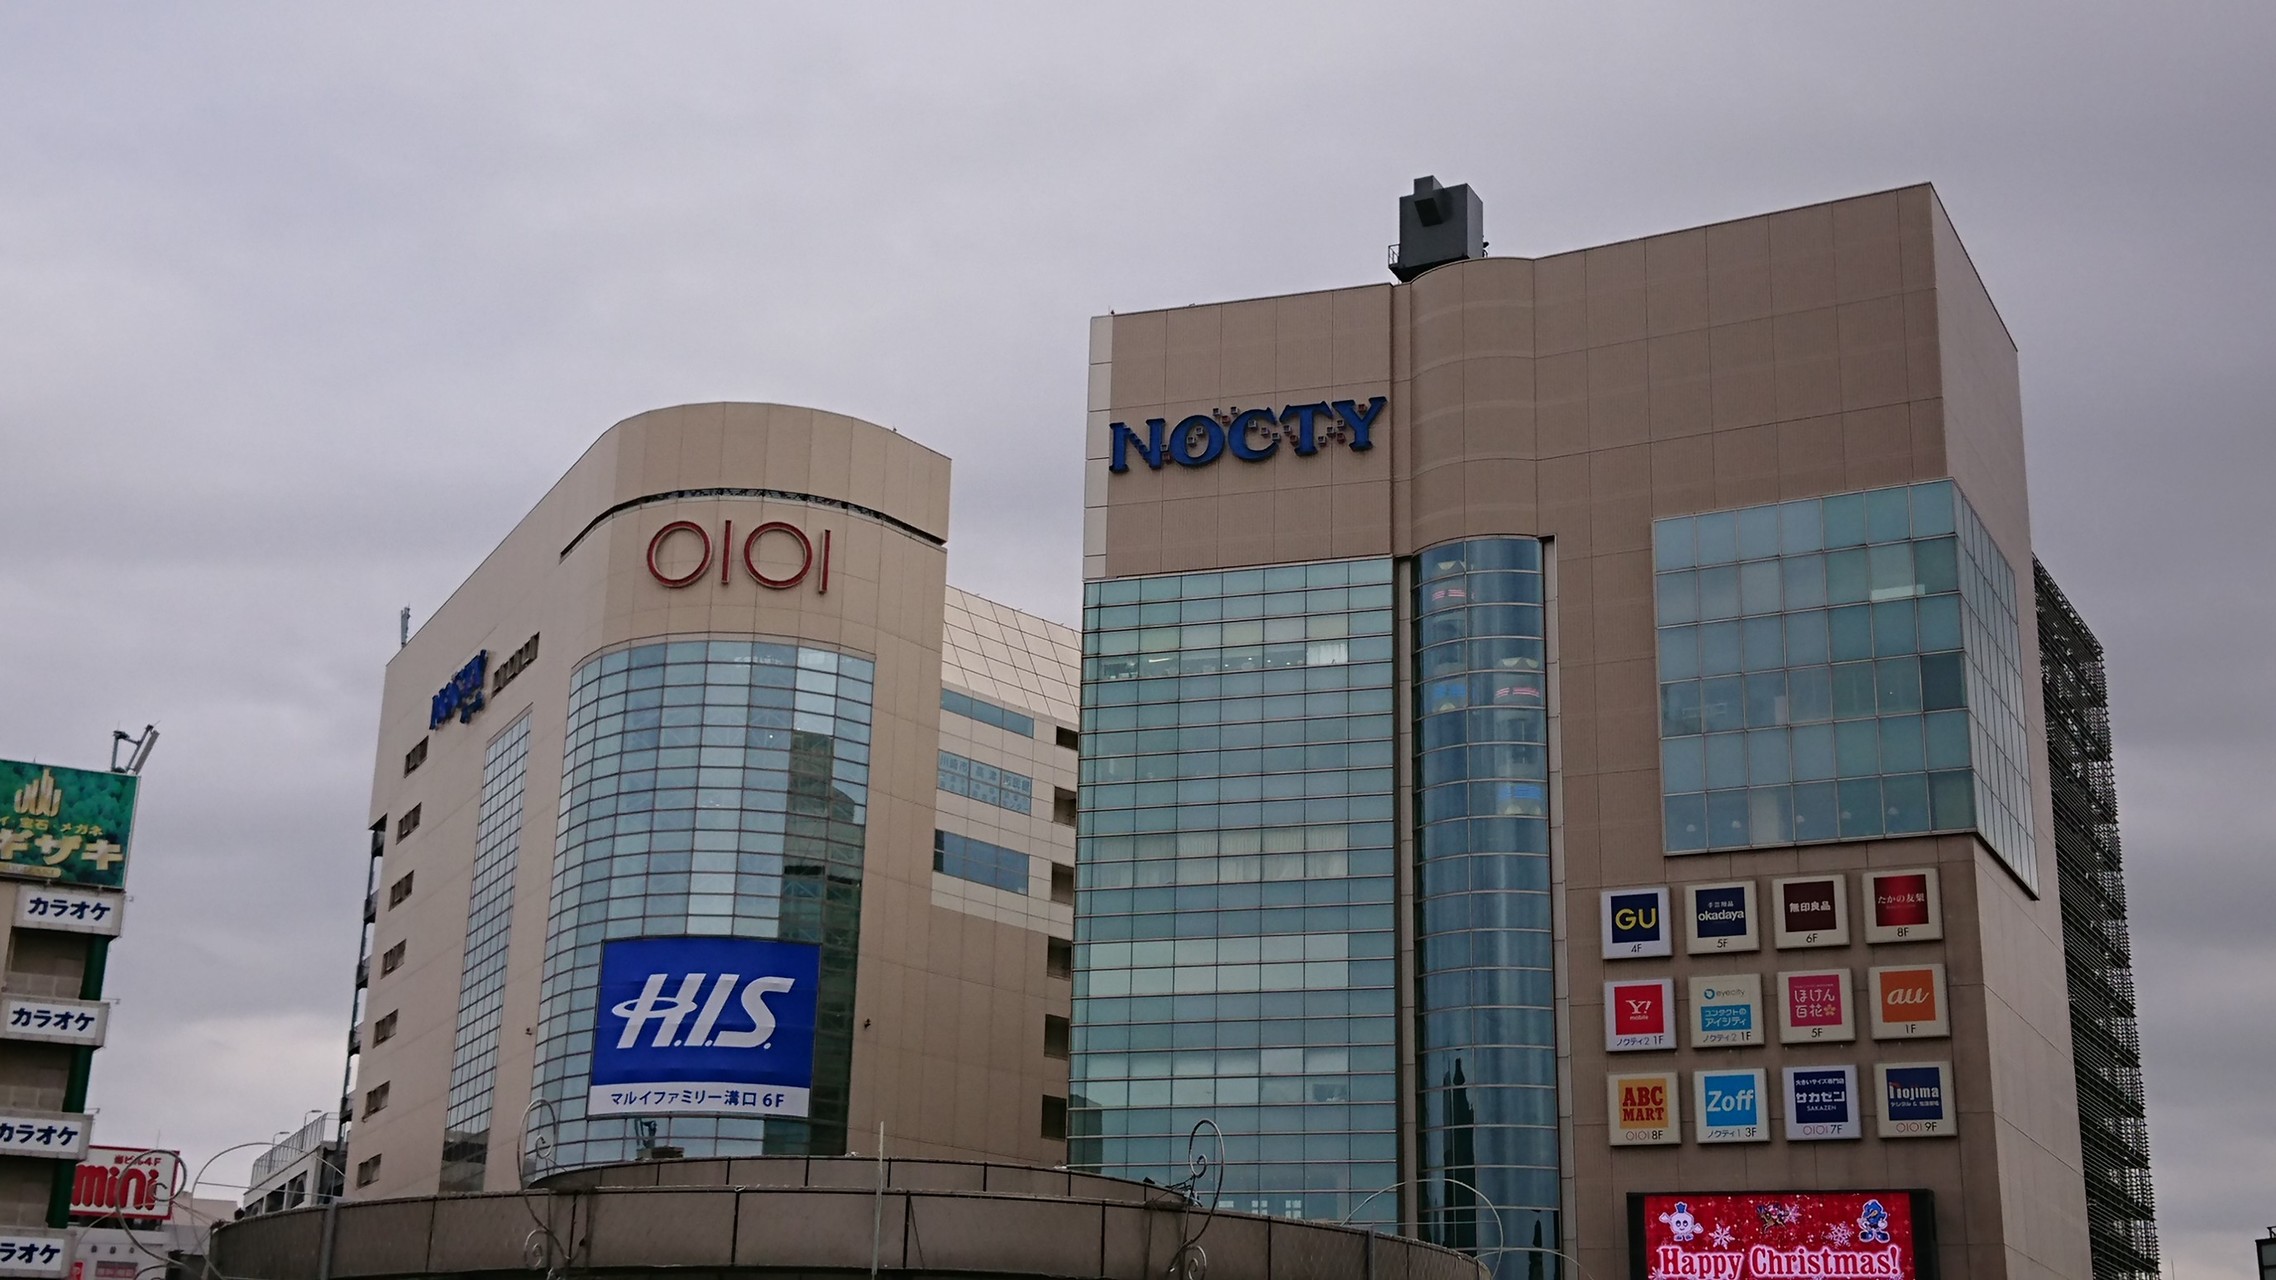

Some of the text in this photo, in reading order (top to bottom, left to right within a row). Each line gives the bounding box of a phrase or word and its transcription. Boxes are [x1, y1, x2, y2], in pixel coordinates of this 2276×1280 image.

[1109, 396, 1388, 473] NOCTY
[1878, 893, 1925, 904] たかの友梨
[27, 897, 111, 921] カラオケ
[1789, 901, 1831, 913] 無印良品
[1615, 908, 1657, 931] GU
[1698, 910, 1745, 922] okadaya
[1806, 933, 1818, 943] 6F
[1897, 927, 1909, 937] 8F
[1631, 944, 1642, 953] 4F
[1717, 939, 1728, 949] 5F
[1716, 989, 1746, 998] eyecity
[1794, 988, 1835, 1003] ほけん
[1887, 987, 1930, 1005] au
[1625, 1000, 1652, 1015] Y!
[1705, 1008, 1747, 1017] コンタクトの
[1795, 1003, 1823, 1018] 百花
[11, 1007, 95, 1032] カラオケ
[1705, 1016, 1746, 1027] アイシティ
[1811, 1028, 1823, 1038] 5F
[1905, 1024, 1916, 1034] 1F
[1653, 1035, 1664, 1045] 1F
[1741, 1031, 1752, 1041] 1F
[610, 1089, 785, 1108] マルイファミリー溝口 6F
[1622, 1086, 1664, 1107] ABC
[1706, 1089, 1754, 1112] Zoff
[1796, 1091, 1845, 1103] サカゼン
[1622, 1107, 1664, 1122] MART
[1745, 1127, 1757, 1137] 3F
[1830, 1124, 1843, 1134] 7F
[1924, 1121, 1938, 1132] 9F
[0, 1123, 78, 1146] カラオケ
[1651, 1130, 1663, 1140] 8F
[71, 1164, 160, 1211] mini
[1660, 1246, 1900, 1279] Happy Christmas!
